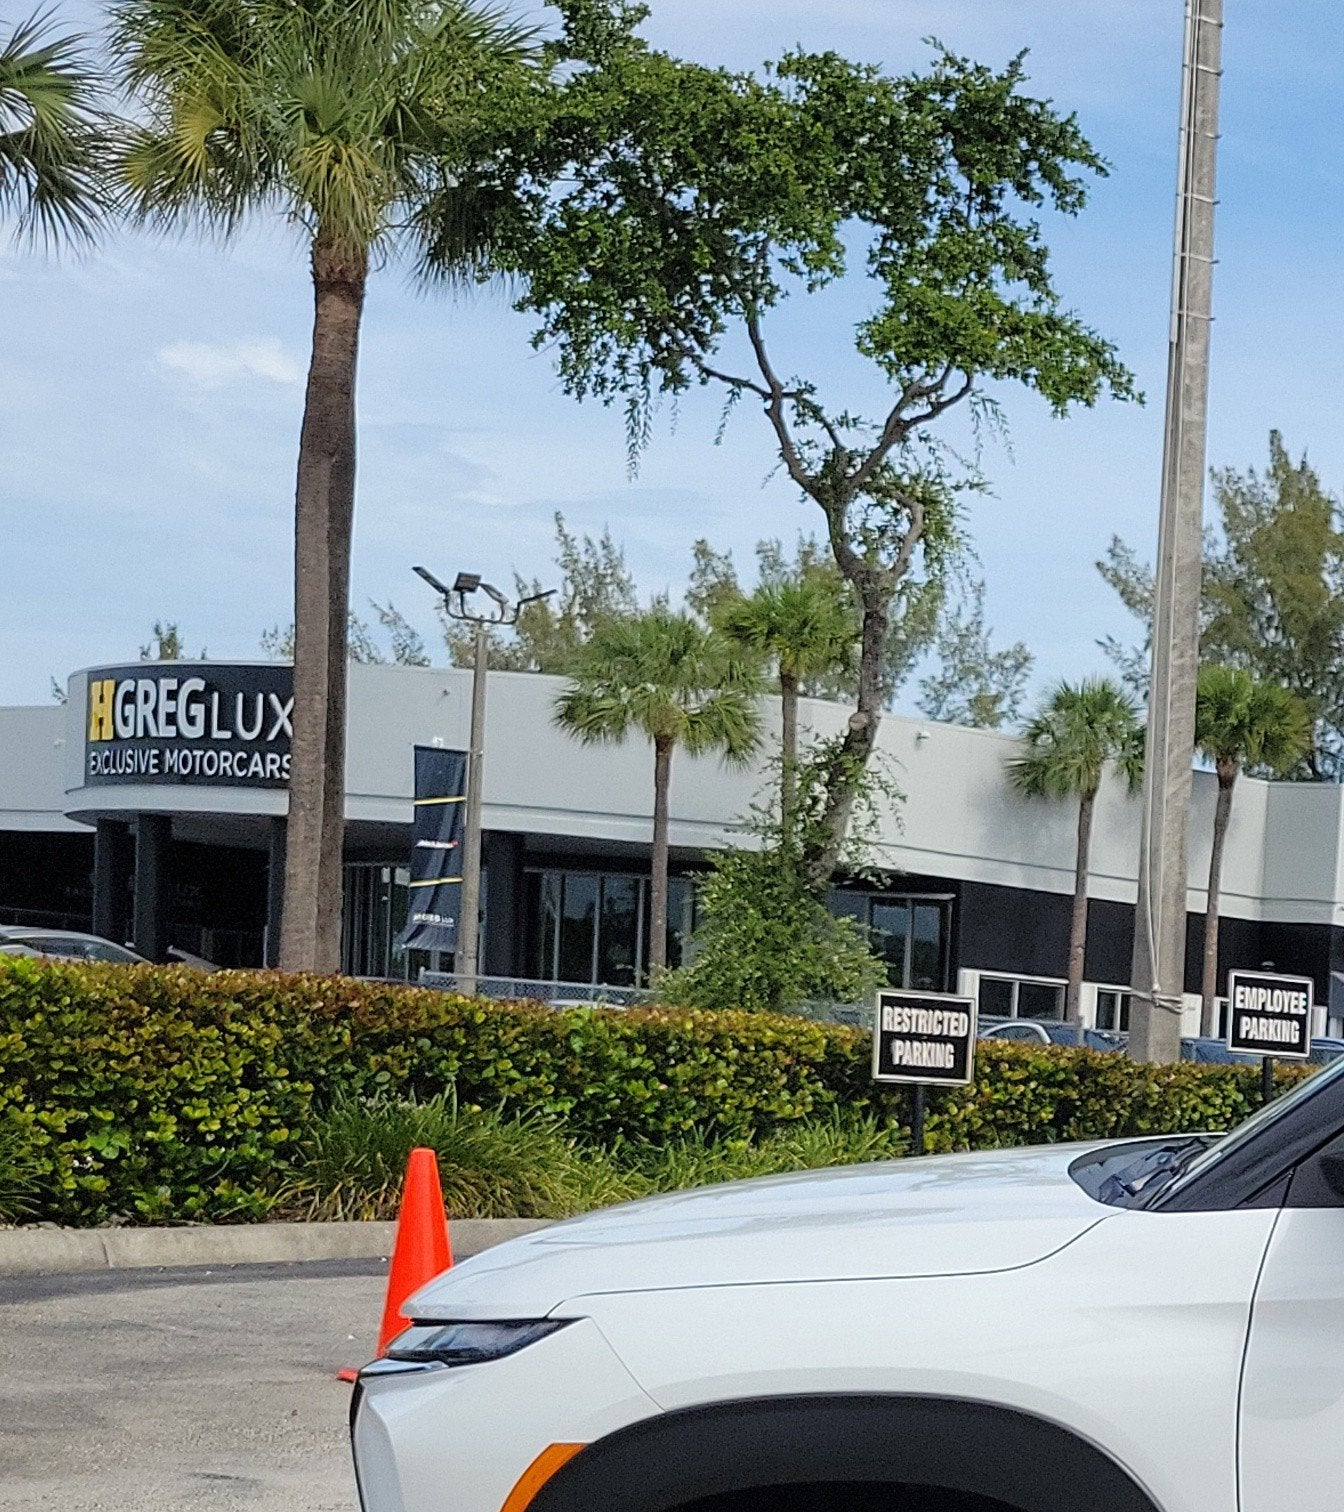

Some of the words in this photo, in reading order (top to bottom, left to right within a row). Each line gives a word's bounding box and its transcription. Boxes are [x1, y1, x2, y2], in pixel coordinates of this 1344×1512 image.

[89, 748, 160, 776] EXCLUSIVE
[163, 748, 291, 781] MOTORCARS
[1235, 985, 1307, 1015] EMPLOYEE
[882, 1005, 969, 1037] RESTRICTED
[1239, 1015, 1300, 1044] PARKING
[891, 1038, 955, 1069] PARKING
